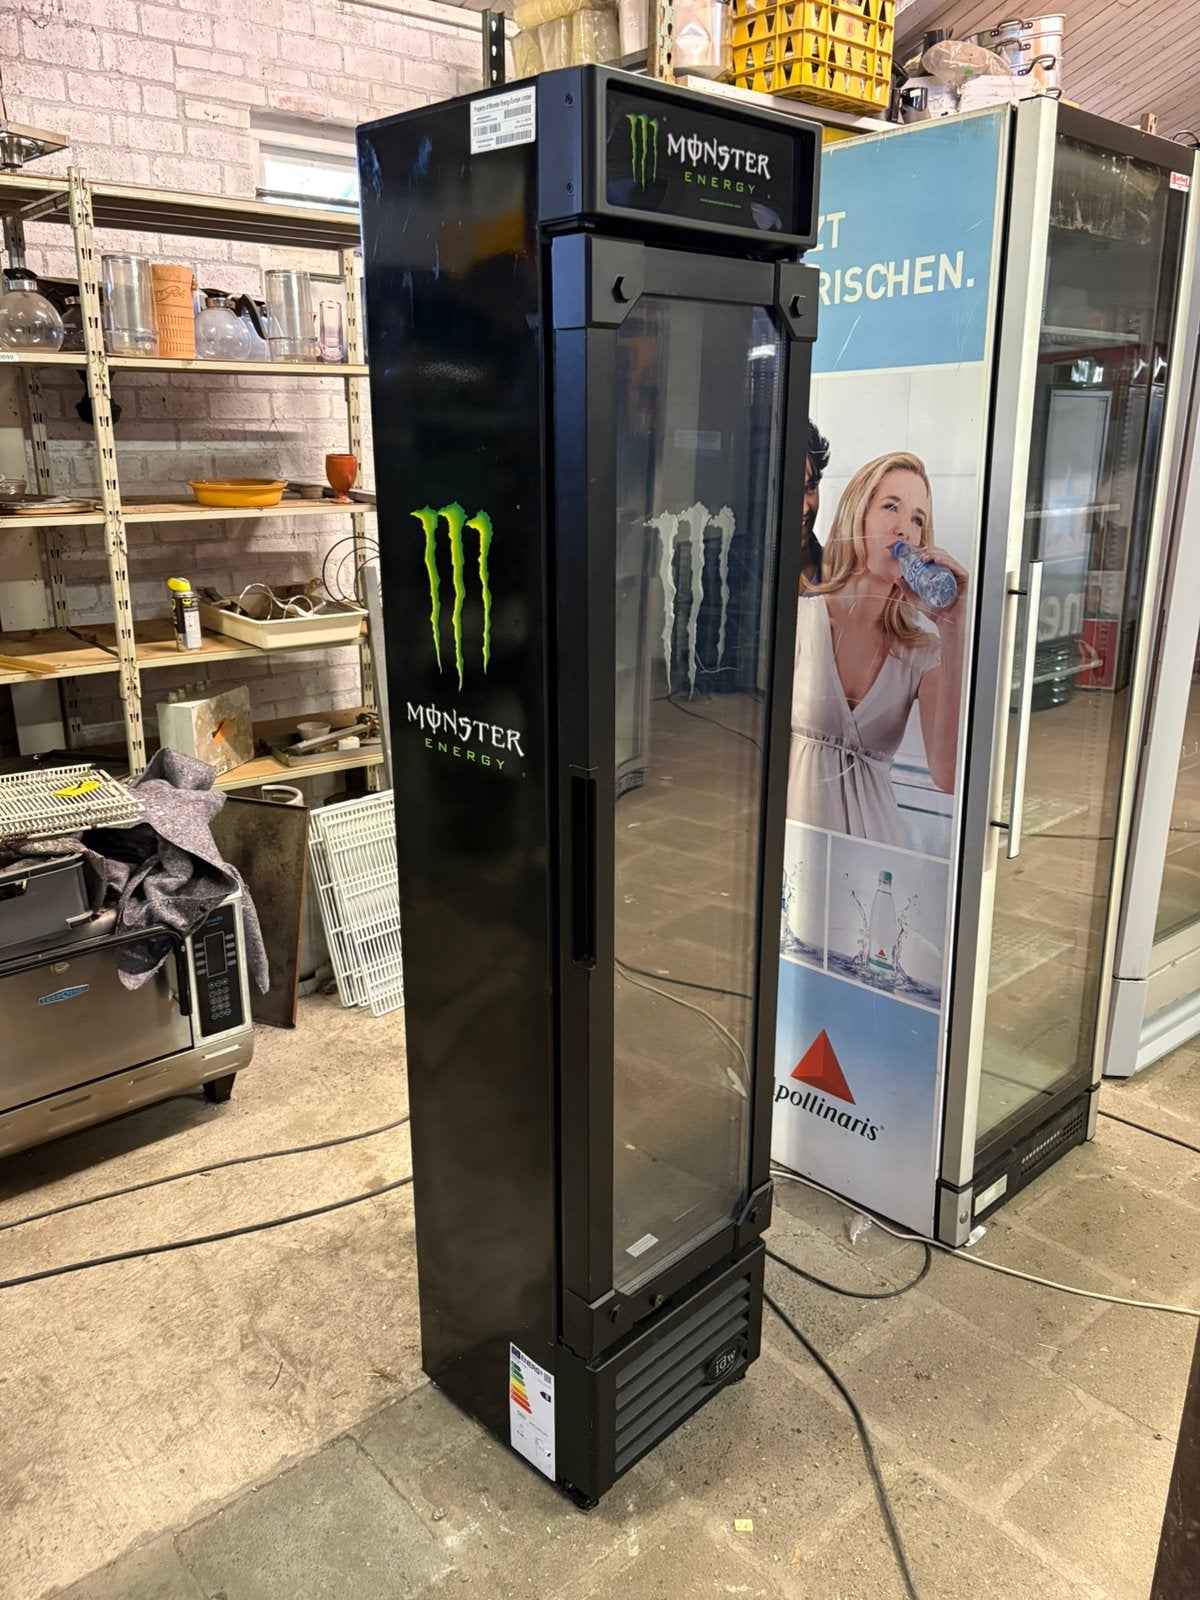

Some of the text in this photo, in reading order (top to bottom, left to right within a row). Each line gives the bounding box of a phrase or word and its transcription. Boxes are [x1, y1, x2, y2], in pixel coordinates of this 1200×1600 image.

[667, 132, 771, 180] MONSTER
[684, 171, 756, 194] ENERGY
[406, 701, 525, 758] MONSTER
[425, 738, 505, 770] ENERGY
[774, 1082, 879, 1141] pollinaris
